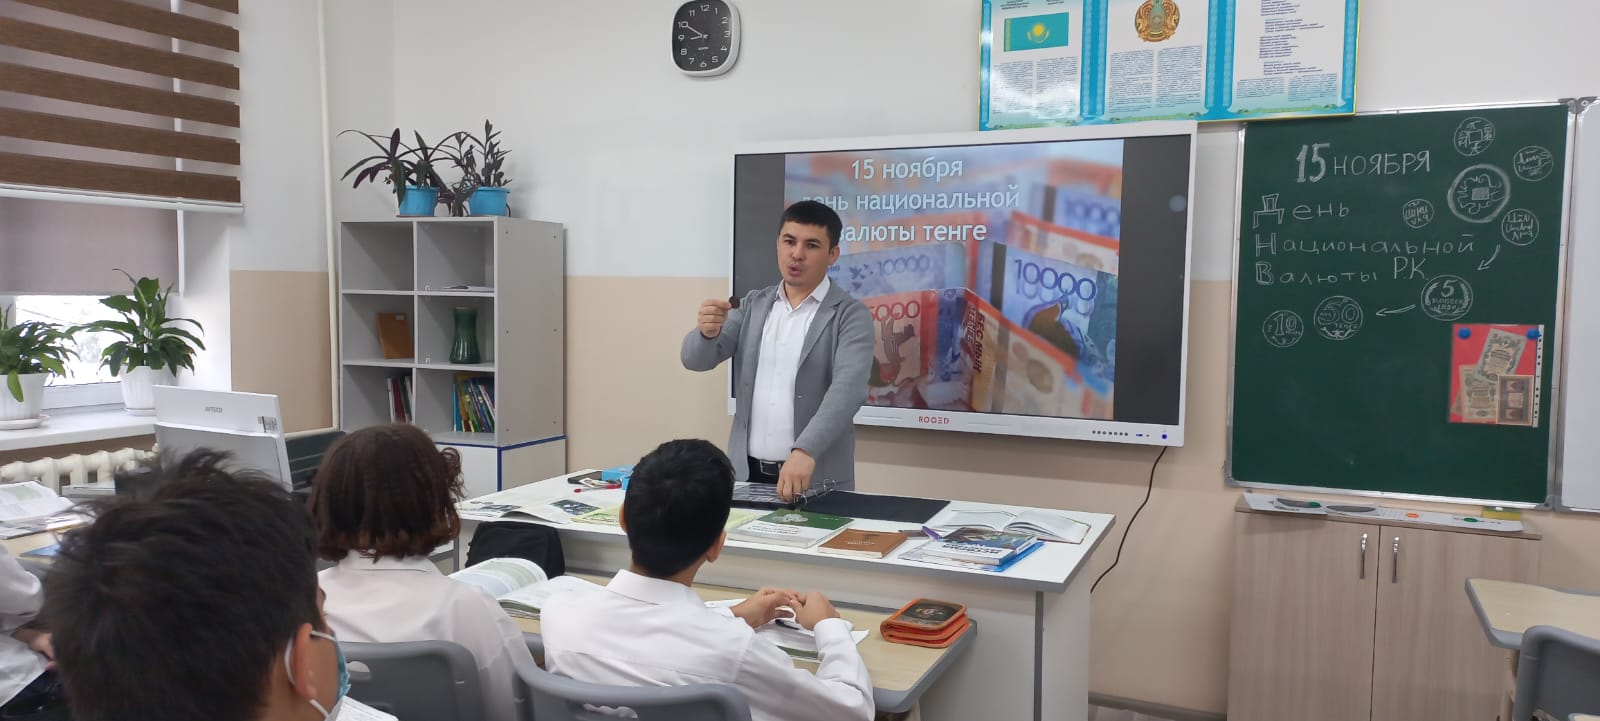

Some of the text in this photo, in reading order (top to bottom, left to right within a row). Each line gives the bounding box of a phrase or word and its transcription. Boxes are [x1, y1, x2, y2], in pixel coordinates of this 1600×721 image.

[688, 9, 696, 17] 11
[700, 4, 710, 12] 12
[678, 20, 689, 28] 10
[721, 16, 728, 24] 2
[723, 30, 731, 38] 3
[711, 55, 719, 63] 5
[851, 156, 964, 183] 15 ноября
[1296, 143, 1431, 183] 15 НОЯБРЯ
[802, 184, 1020, 214] ень национальной
[1252, 193, 1350, 229] День
[922, 223, 988, 242] тенге
[1255, 232, 1474, 257] Национальной
[877, 254, 931, 275] 10000
[1255, 261, 1377, 286] Валюты
[1014, 258, 1097, 302] 10000
[1440, 279, 1459, 298] 5
[1273, 313, 1297, 336] 10
[1318, 302, 1360, 325] 50
